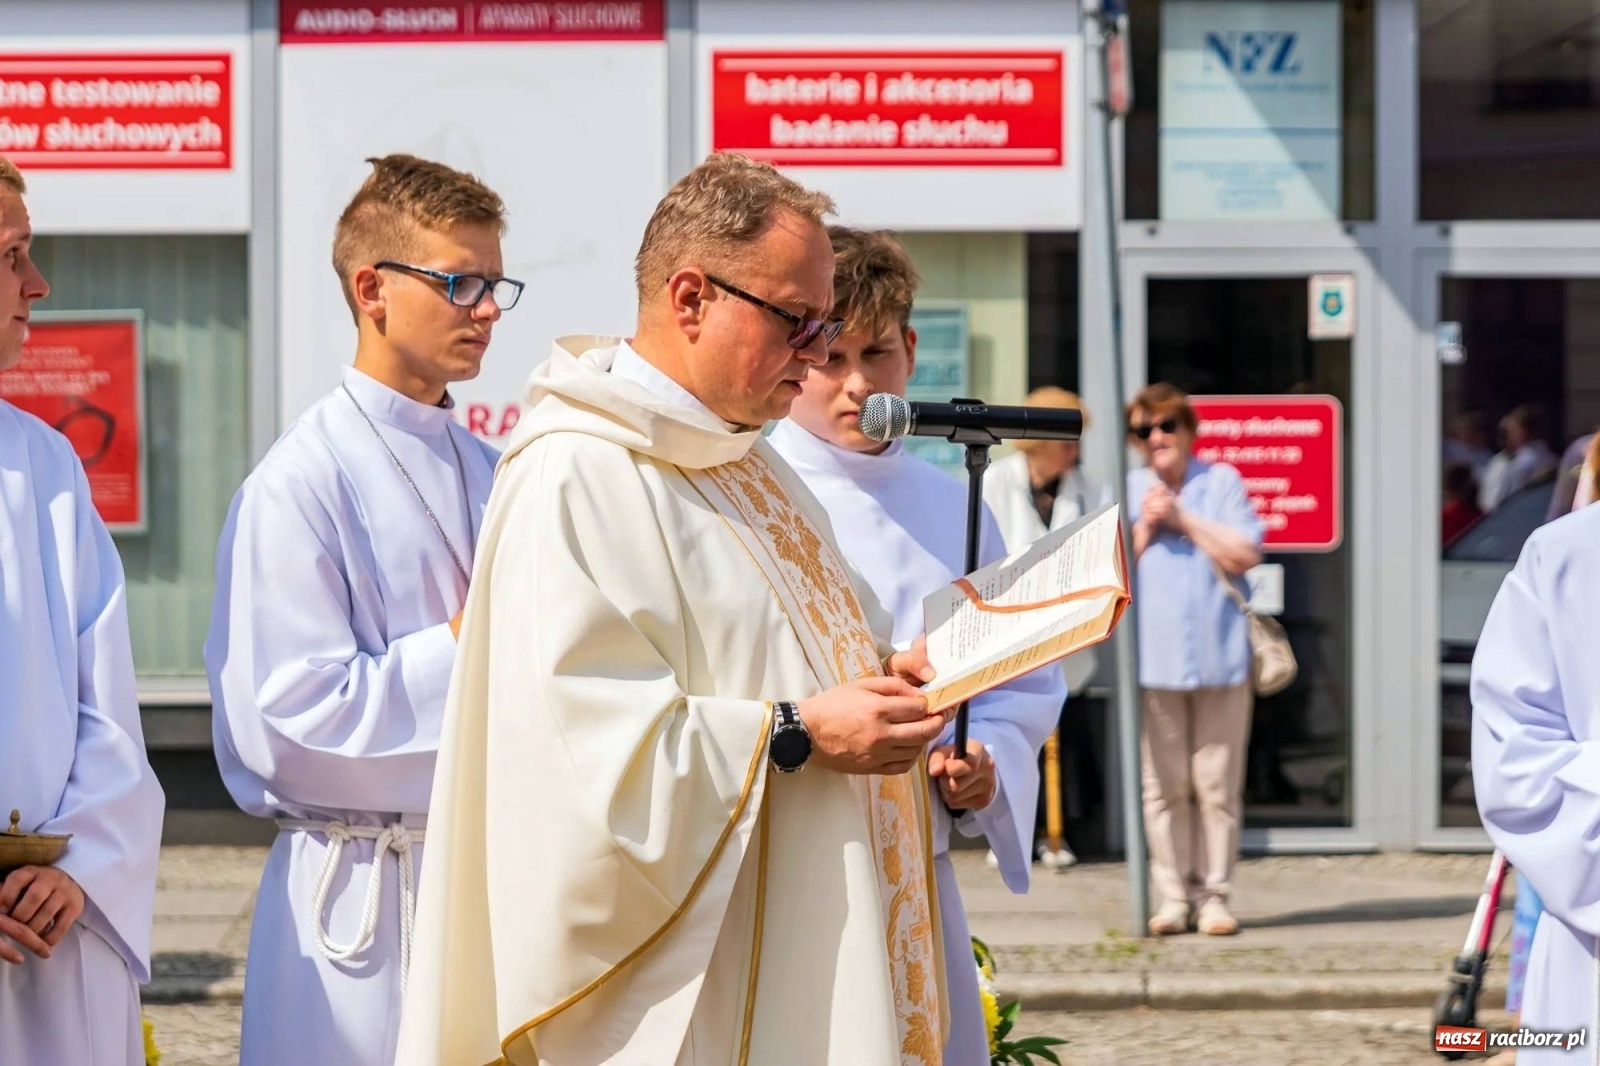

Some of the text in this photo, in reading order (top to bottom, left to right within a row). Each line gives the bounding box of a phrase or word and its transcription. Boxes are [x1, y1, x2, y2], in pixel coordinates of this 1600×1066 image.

[1204, 31, 1302, 74] NFZ
[51, 75, 221, 108] testowanie
[745, 72, 1034, 105] baterie i akcesoria
[43, 116, 222, 157] słuchowych
[770, 114, 1009, 147] badanie słuchu
